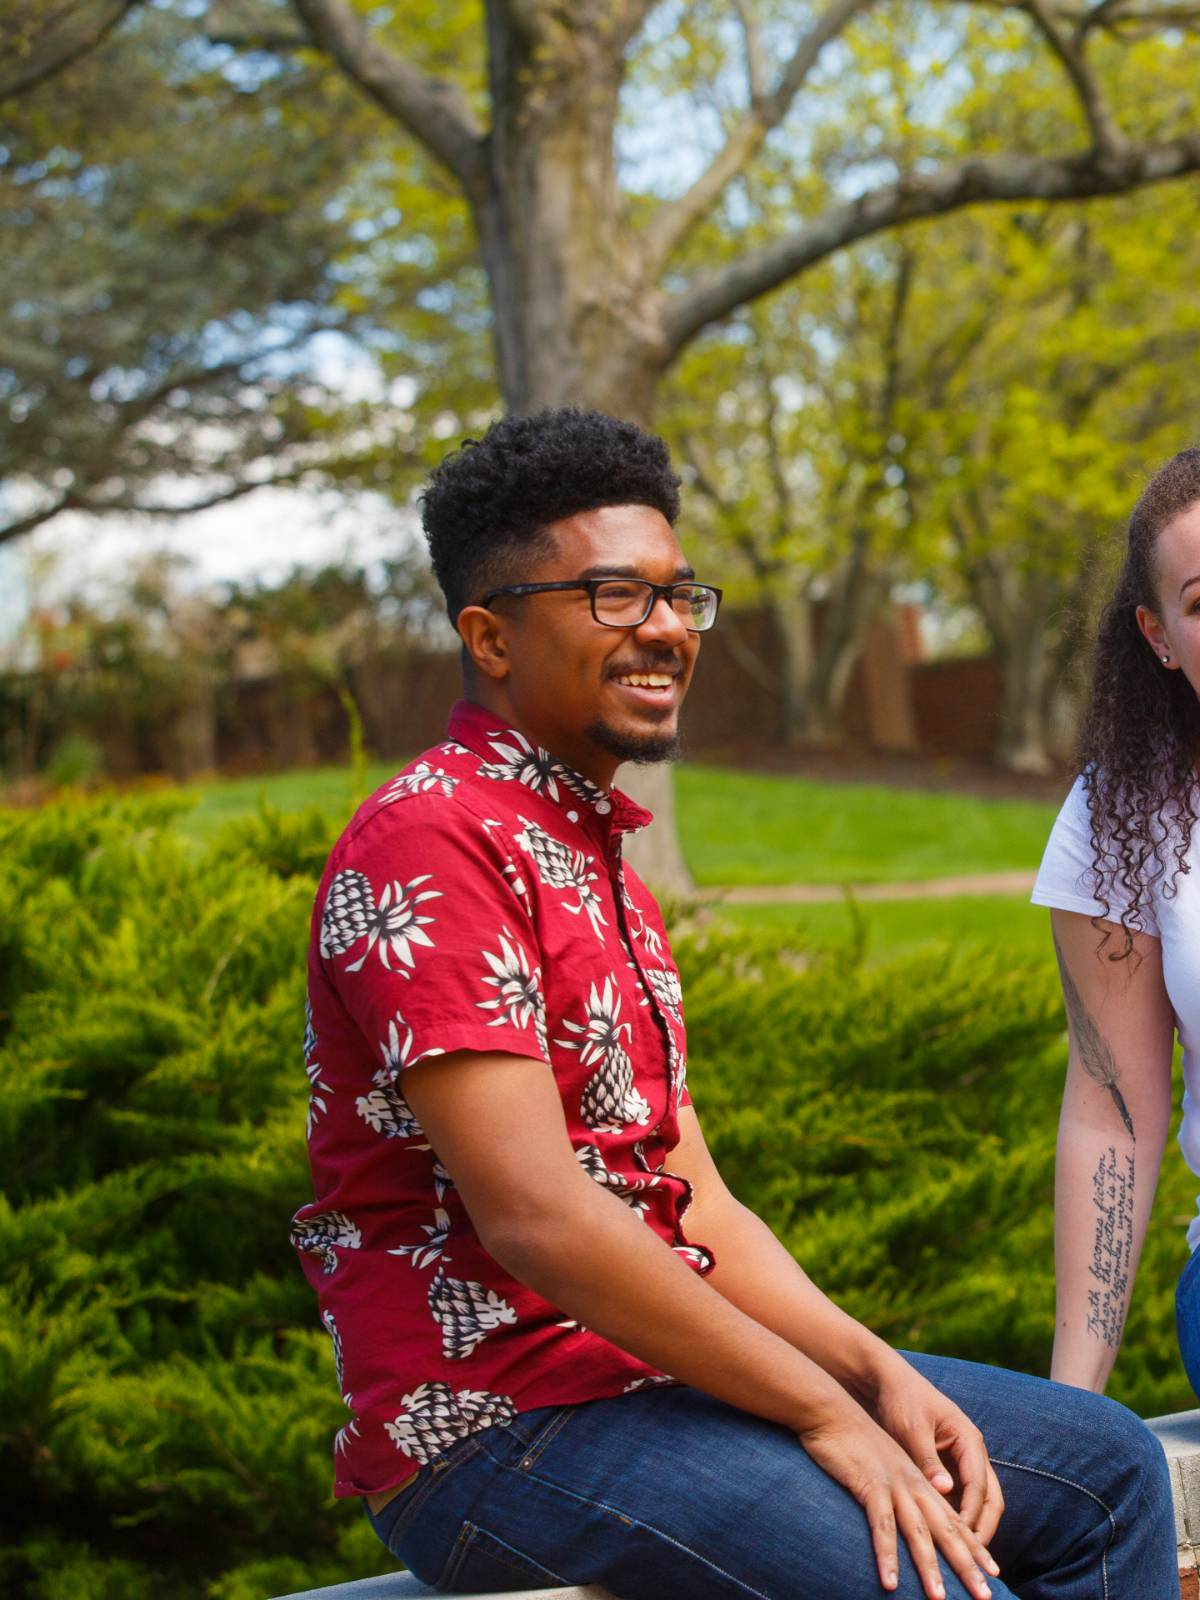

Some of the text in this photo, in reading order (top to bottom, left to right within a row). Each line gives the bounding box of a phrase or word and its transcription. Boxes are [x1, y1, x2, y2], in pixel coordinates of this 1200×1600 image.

[1086, 1153, 1109, 1340] Truth becomes fiction
[1100, 1146, 1117, 1339] where the fiction is true
[1110, 1239, 1122, 1300] becomes
[1117, 1173, 1126, 1229] unreal
[1124, 1215, 1132, 1267] unreal
[1126, 1198, 1134, 1213] is
[1119, 1273, 1128, 1295] the
